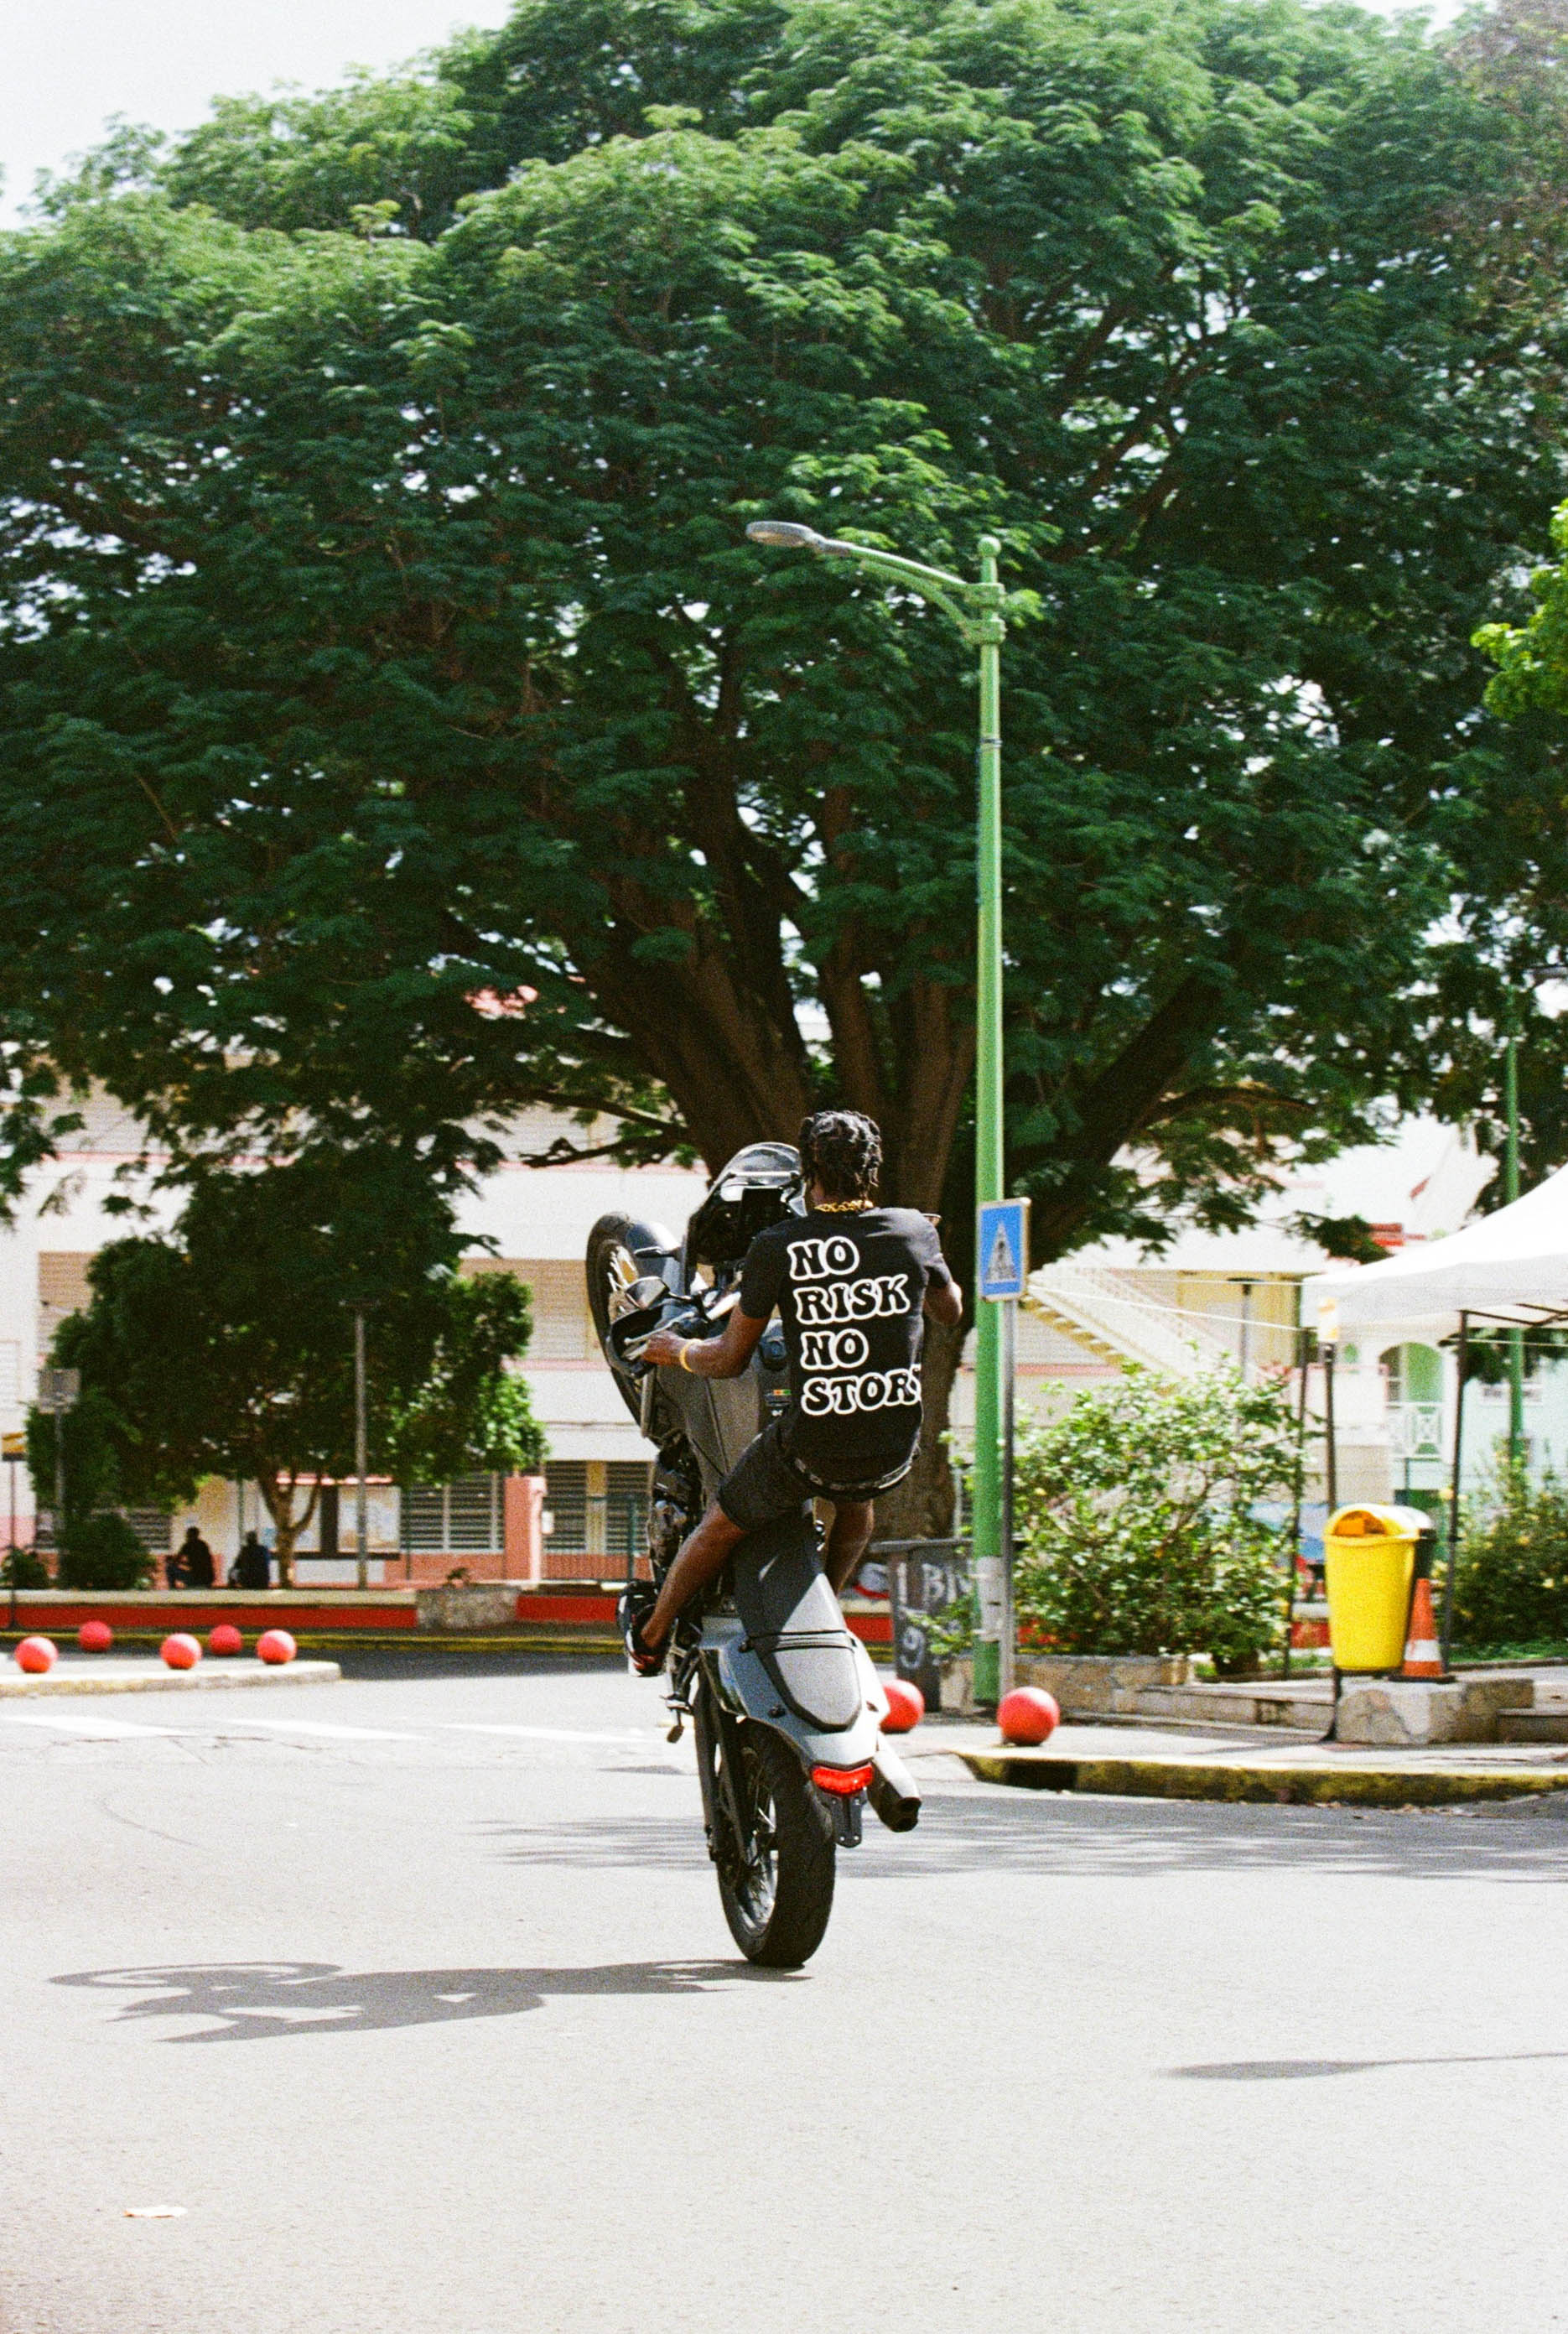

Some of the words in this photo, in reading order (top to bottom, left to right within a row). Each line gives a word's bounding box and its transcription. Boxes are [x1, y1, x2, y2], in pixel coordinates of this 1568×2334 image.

[787, 1235, 859, 1281] NO
[792, 1274, 911, 1324] RISK
[800, 1328, 870, 1370] NO
